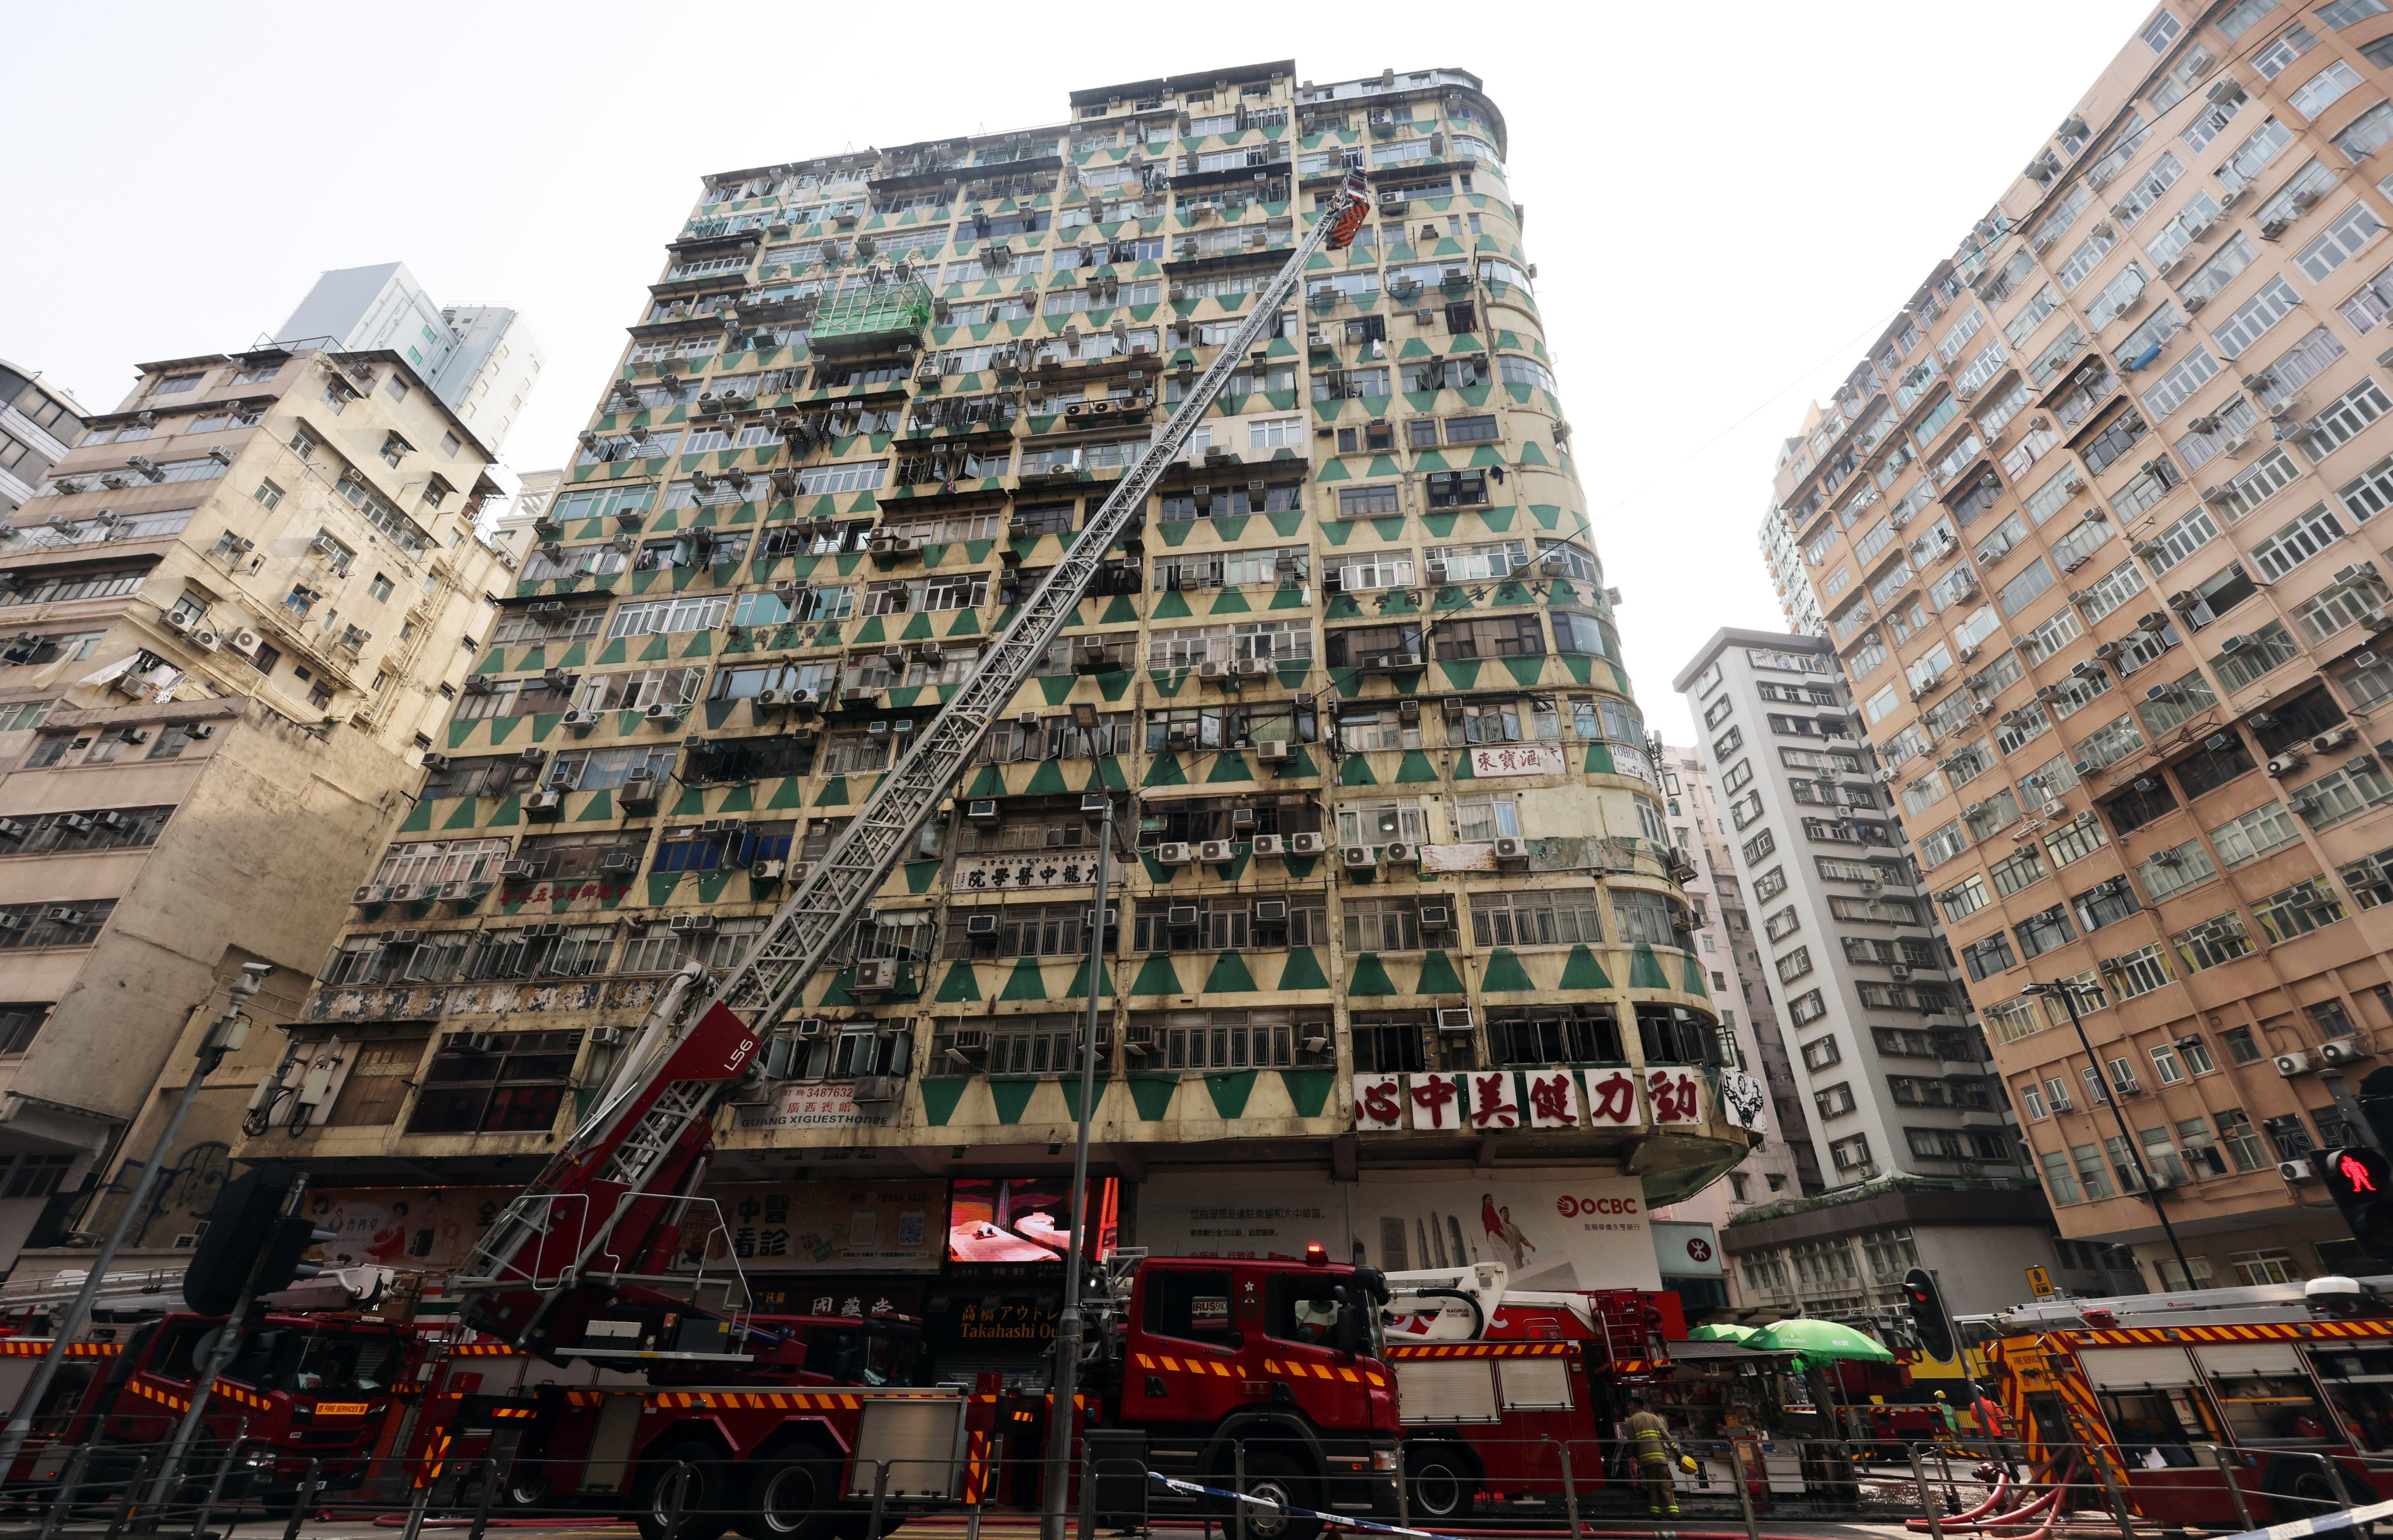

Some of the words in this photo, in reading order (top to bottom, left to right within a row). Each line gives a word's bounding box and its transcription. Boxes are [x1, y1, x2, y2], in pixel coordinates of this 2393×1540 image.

[1478, 750, 1558, 772] 東寶酒
[968, 863, 1098, 887] 九龍中醫學院
[723, 1039, 753, 1071] L56
[787, 1102, 852, 1113] 廣西賓館
[738, 1195, 790, 1223] 中醫
[1581, 1198, 1637, 1215] OCBC
[734, 1227, 790, 1258] 看診
[961, 1322, 1035, 1338] Takahashi
